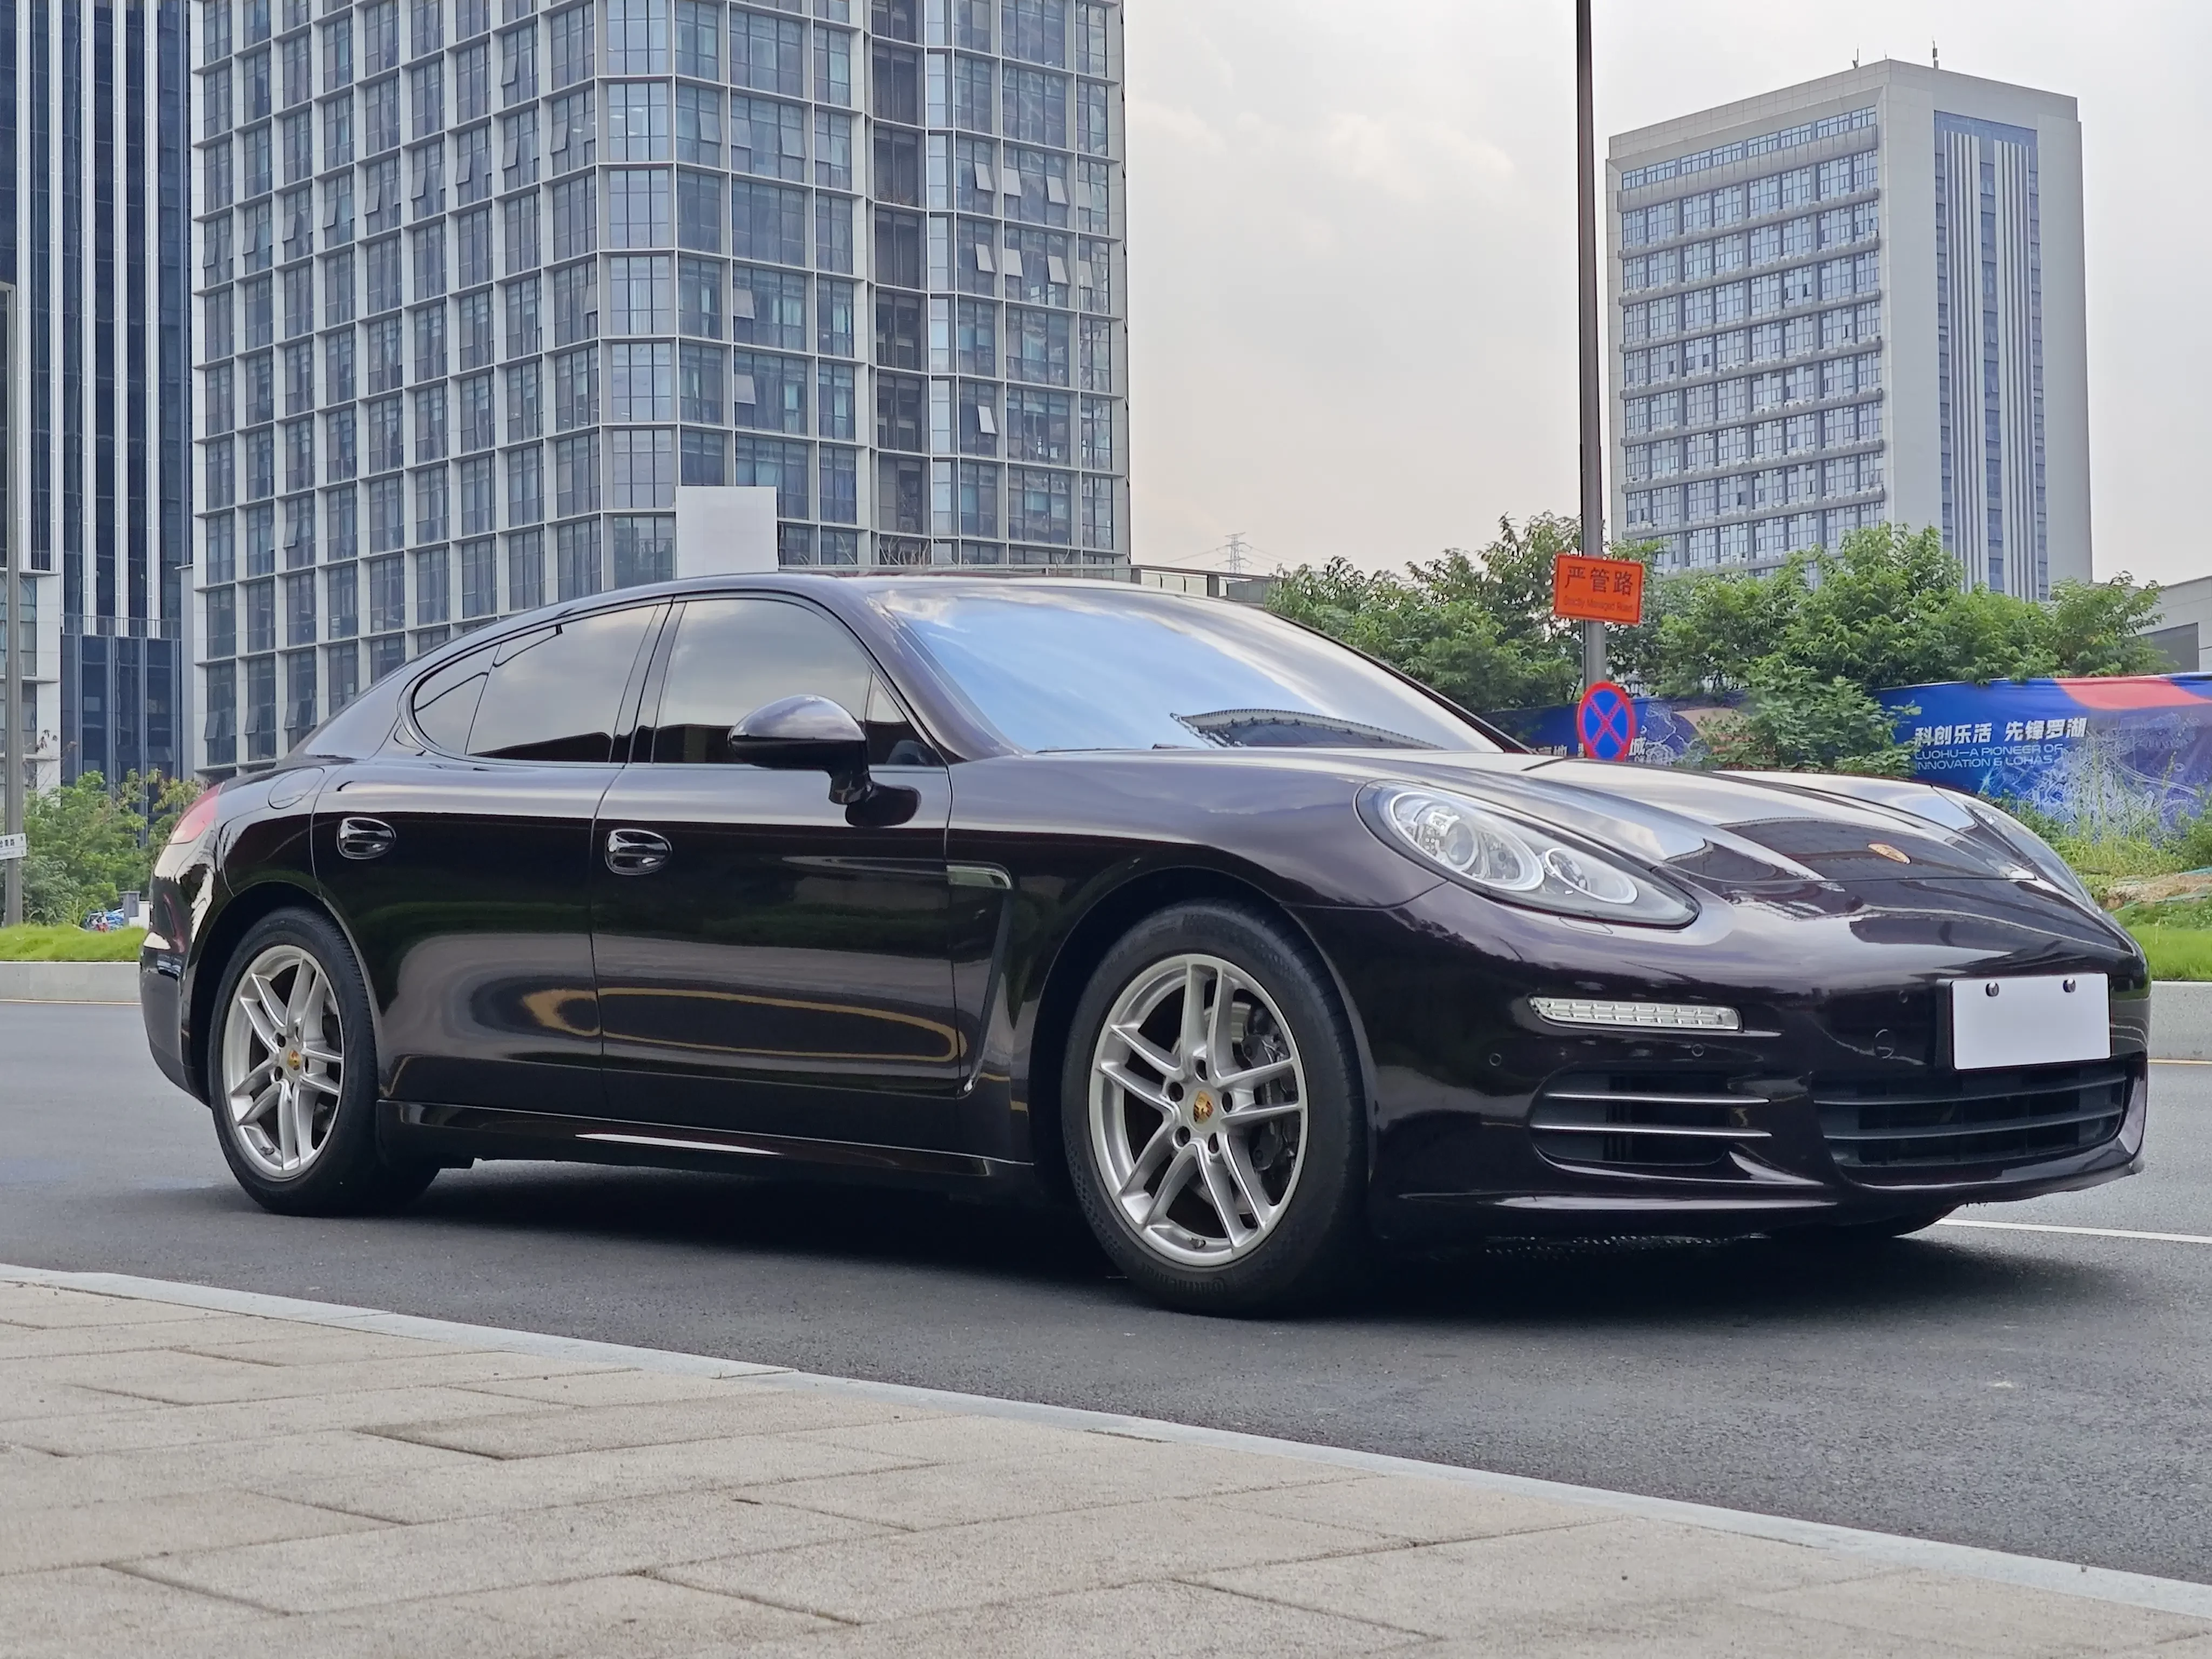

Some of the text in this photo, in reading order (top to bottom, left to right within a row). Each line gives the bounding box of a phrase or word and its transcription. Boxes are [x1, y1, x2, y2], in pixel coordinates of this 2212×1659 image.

[1564, 567, 1633, 596] 严管路
[1914, 717, 2088, 746] 科创乐活 先锋罗湖
[1981, 744, 2041, 757] PIONEER
[2044, 743, 2063, 755] OF
[1917, 755, 2053, 771] NNOVATION & LOHAS
